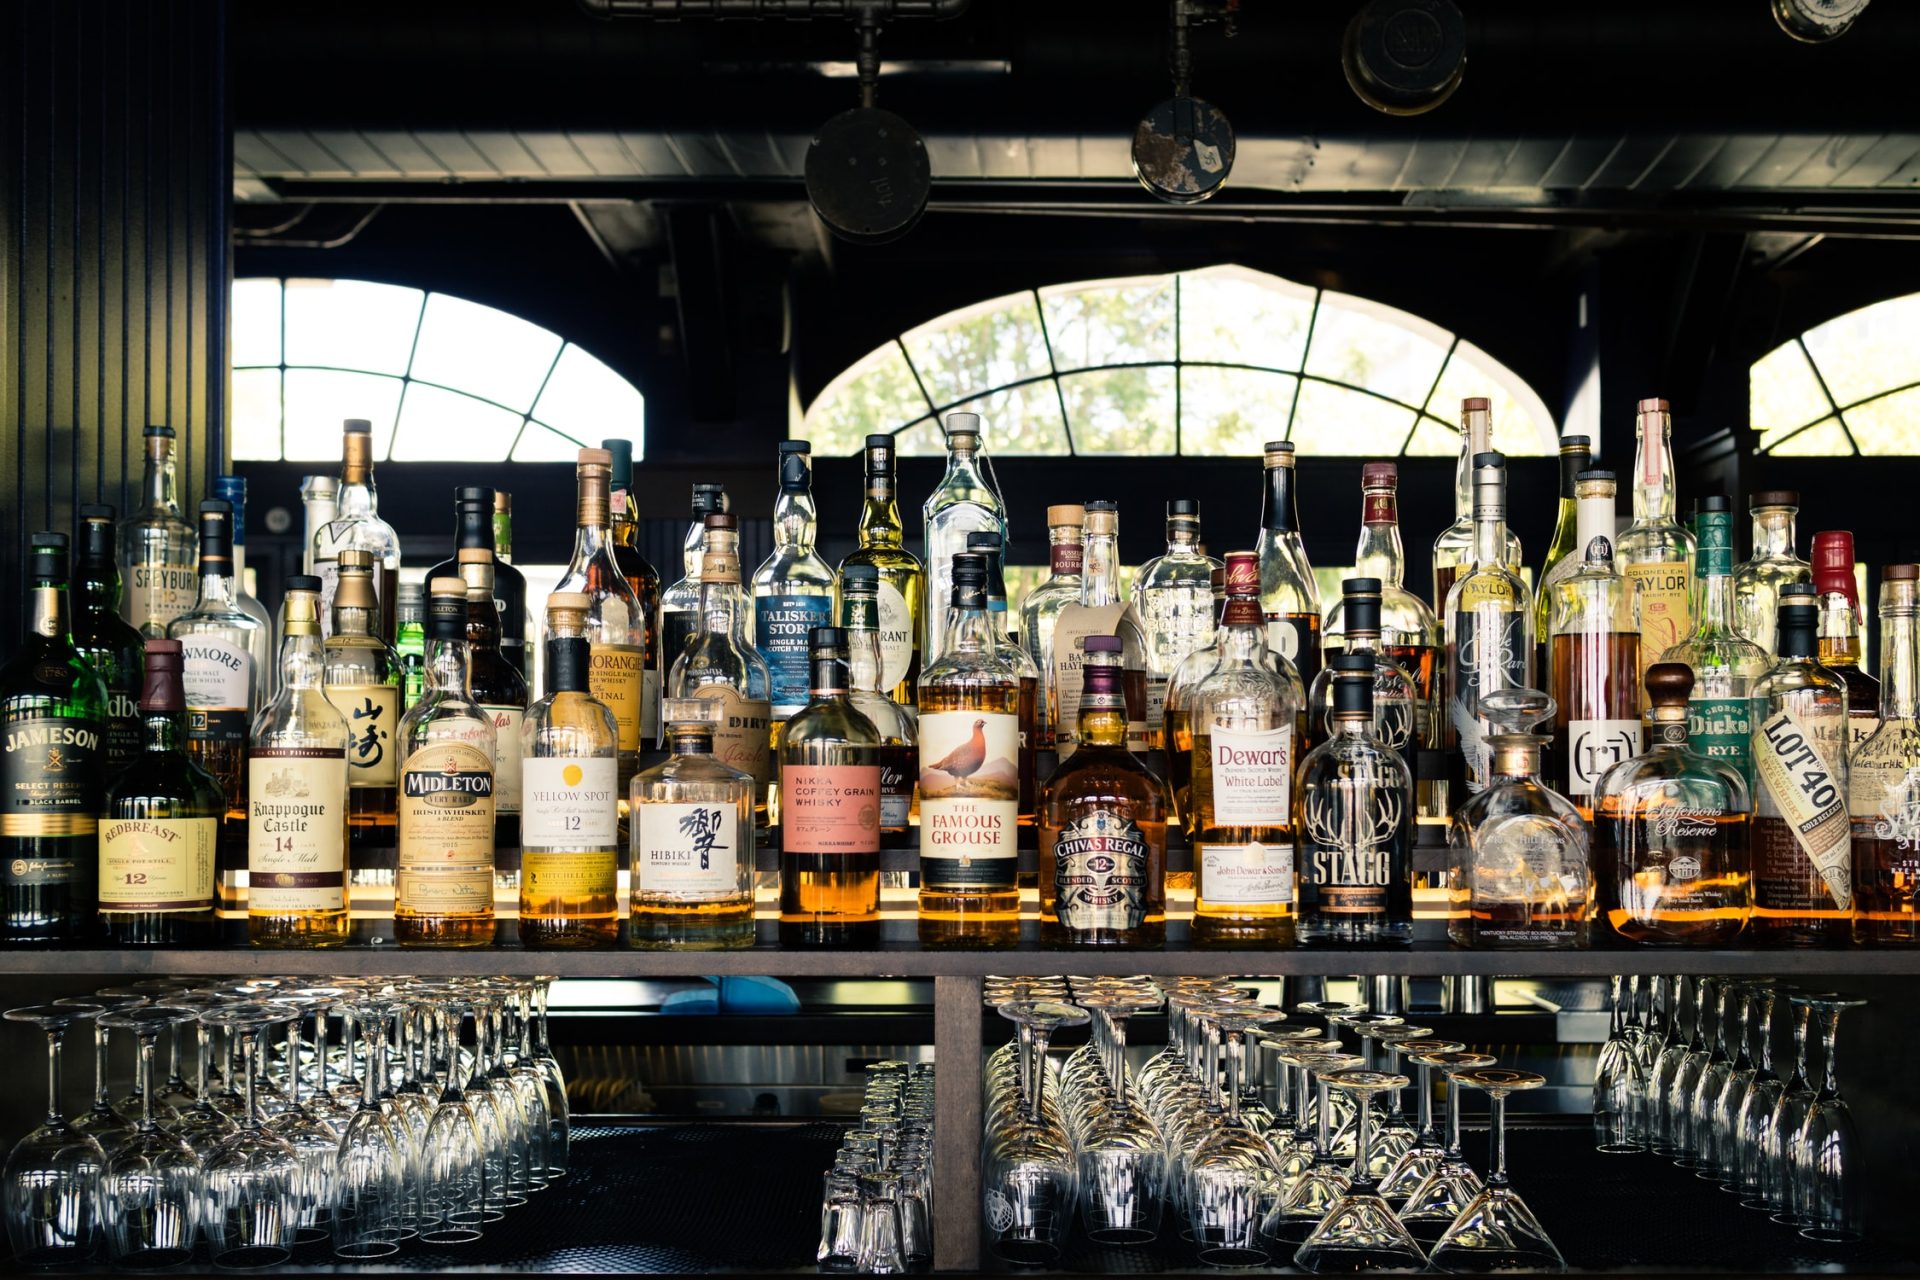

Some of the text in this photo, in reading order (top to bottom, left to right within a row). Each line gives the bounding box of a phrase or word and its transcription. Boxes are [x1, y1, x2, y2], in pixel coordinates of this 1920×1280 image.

[1055, 561, 1083, 569] BOURBO
[1637, 576, 1686, 590] AYLOR
[761, 611, 827, 622] TALISKER
[880, 631, 908, 642] RANT
[182, 647, 242, 671] WMORE
[589, 655, 641, 670] ORANGIE
[594, 692, 625, 701] GINAL
[107, 695, 141, 718] dbe
[1705, 705, 1743, 715] GEORGE
[191, 715, 205, 727] 12
[5, 727, 99, 752] JAMESON
[1219, 746, 1287, 765] Dewar's
[1707, 746, 1740, 755] RYE
[1764, 715, 1837, 808] LOT 40
[407, 773, 491, 793] MIDLETON
[795, 777, 832, 785] NIKKA
[795, 788, 840, 796] COFFEY
[844, 788, 875, 796] GRAIN
[1763, 758, 1804, 820] RYE WHISKY
[533, 791, 611, 801] YELLOW SPOT
[253, 801, 325, 818] Knappogue
[795, 799, 841, 807] WHISKY
[564, 816, 581, 830] 12
[932, 815, 1001, 828] FAMOUS
[1801, 803, 1843, 832] 2012 RELEASE
[263, 818, 308, 832] Castle
[1655, 816, 1717, 836] Reserve
[104, 821, 179, 844] REDBREAST
[931, 831, 1001, 844] GROUSE
[275, 836, 293, 852] 14
[1057, 838, 1145, 858] CHIVAS REGAL
[651, 850, 691, 860] HIBIKI
[1094, 859, 1107, 870] 12
[1217, 866, 1236, 875] John
[1236, 866, 1261, 875] Dewar
[1313, 851, 1390, 885] STAGG
[125, 873, 148, 884] 12
[1084, 894, 1118, 904] WHISKY
